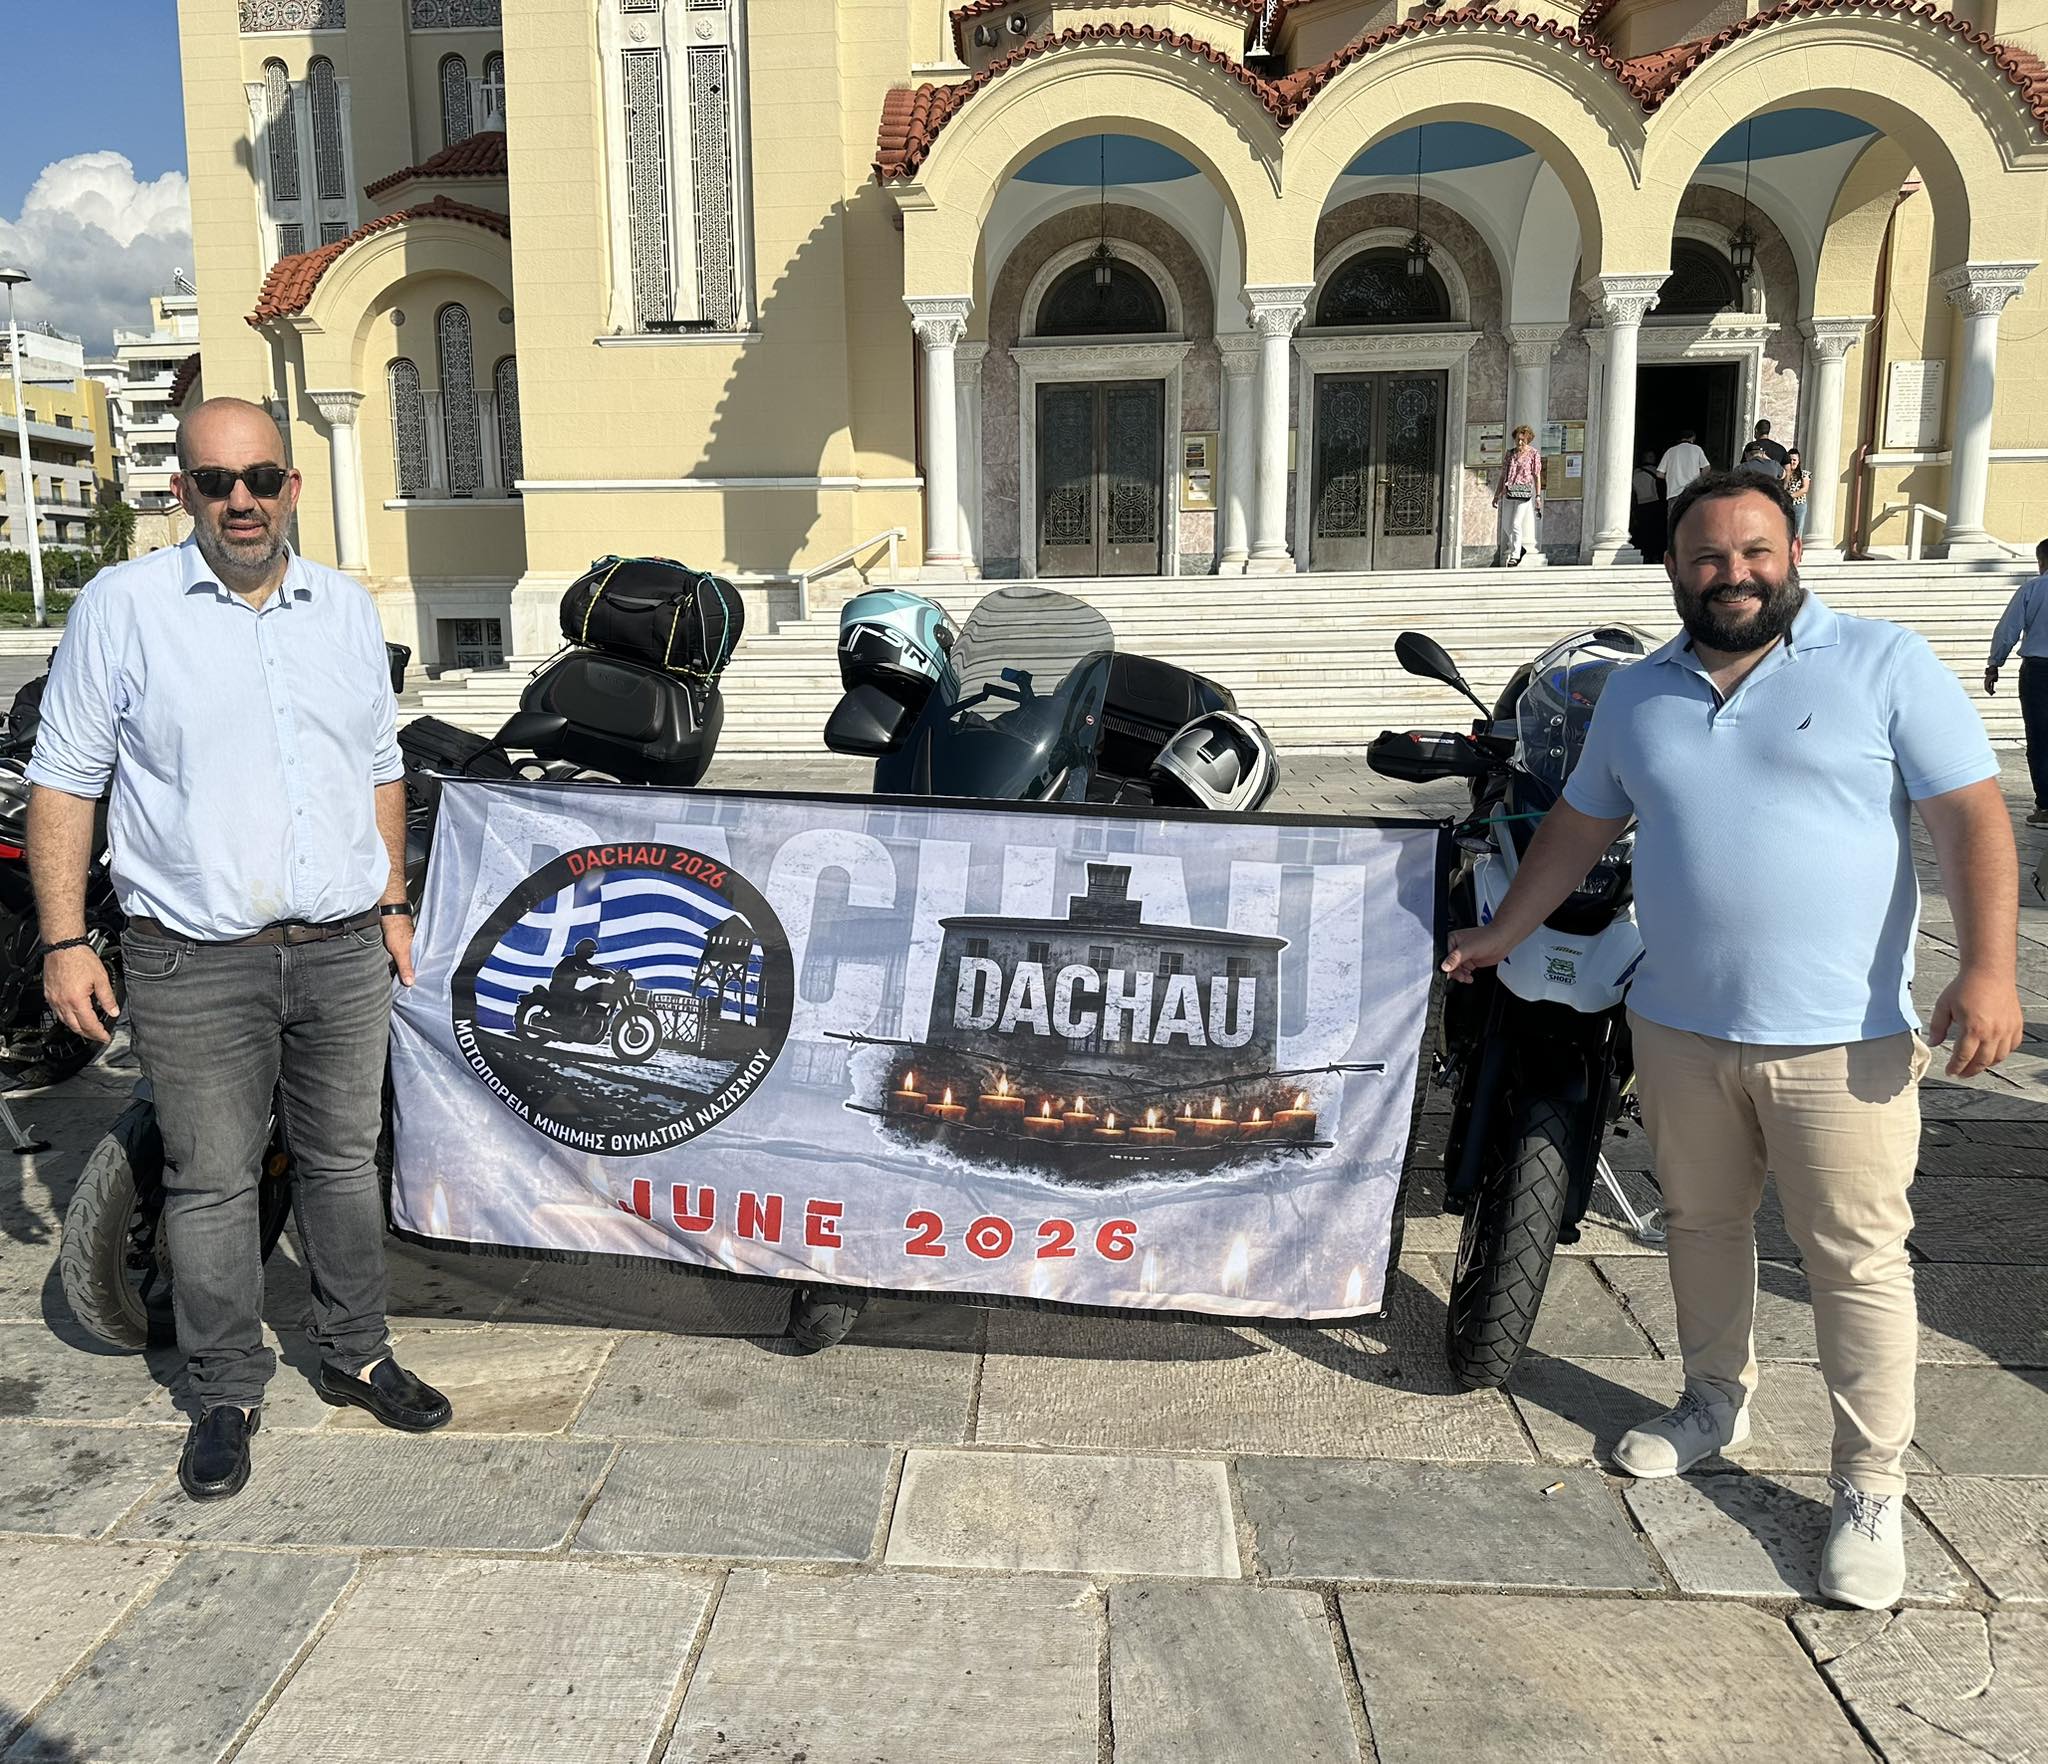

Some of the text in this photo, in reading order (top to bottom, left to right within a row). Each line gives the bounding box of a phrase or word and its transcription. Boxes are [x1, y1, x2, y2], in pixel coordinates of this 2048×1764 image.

[566, 846, 729, 891] DACHAU 2026
[952, 955, 1257, 1049] DACHAU
[454, 1018, 772, 1152] ΜΟΤΟΠΟΡΕΙΑ ΜΝΗΜΗΣ ΘΥΜΑΤΩΝ ΝΑΖΙΣΜΟΥ
[617, 1177, 1139, 1262] JUNE 2026
